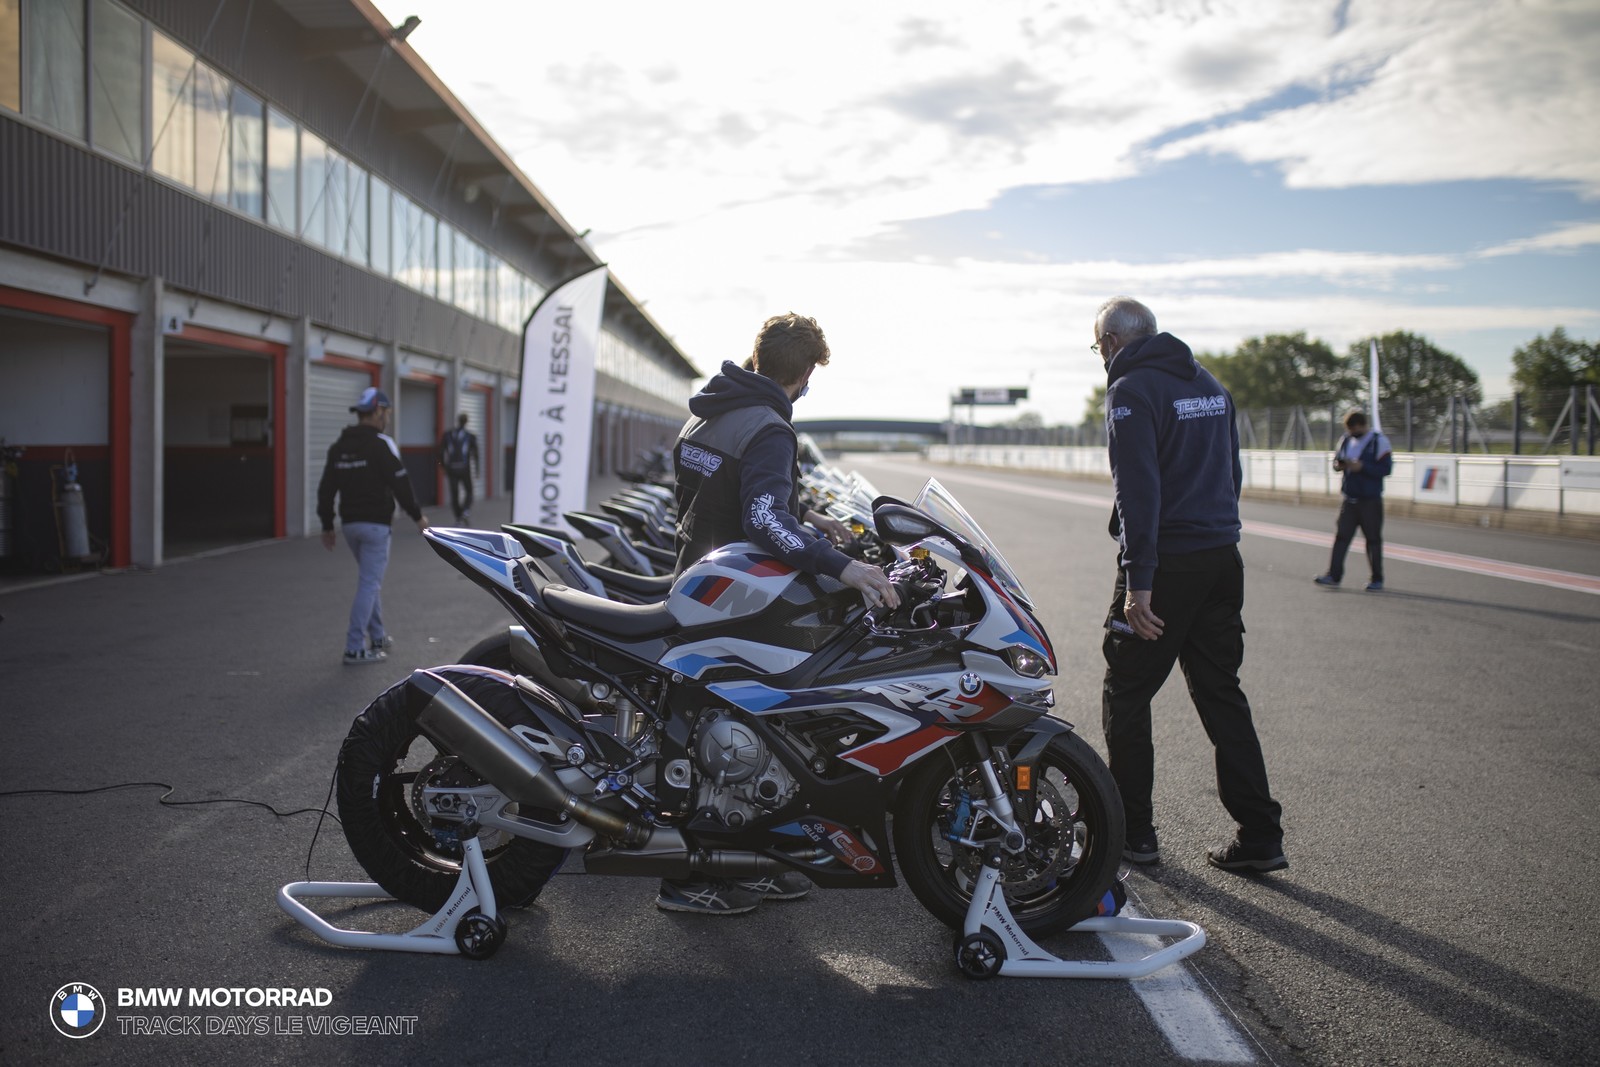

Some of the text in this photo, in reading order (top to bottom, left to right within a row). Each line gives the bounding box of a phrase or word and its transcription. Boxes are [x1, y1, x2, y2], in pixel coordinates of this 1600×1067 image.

[168, 316, 178, 331] 4
[1173, 395, 1226, 415] TECMAS
[1178, 411, 1205, 420] RACING
[540, 306, 573, 526] MOTOS À L'ESSAI
[767, 531, 790, 554] TEAM
[801, 824, 821, 842] GILLES
[446, 886, 471, 917] Motorrad
[1004, 924, 1030, 956] Motorrad
